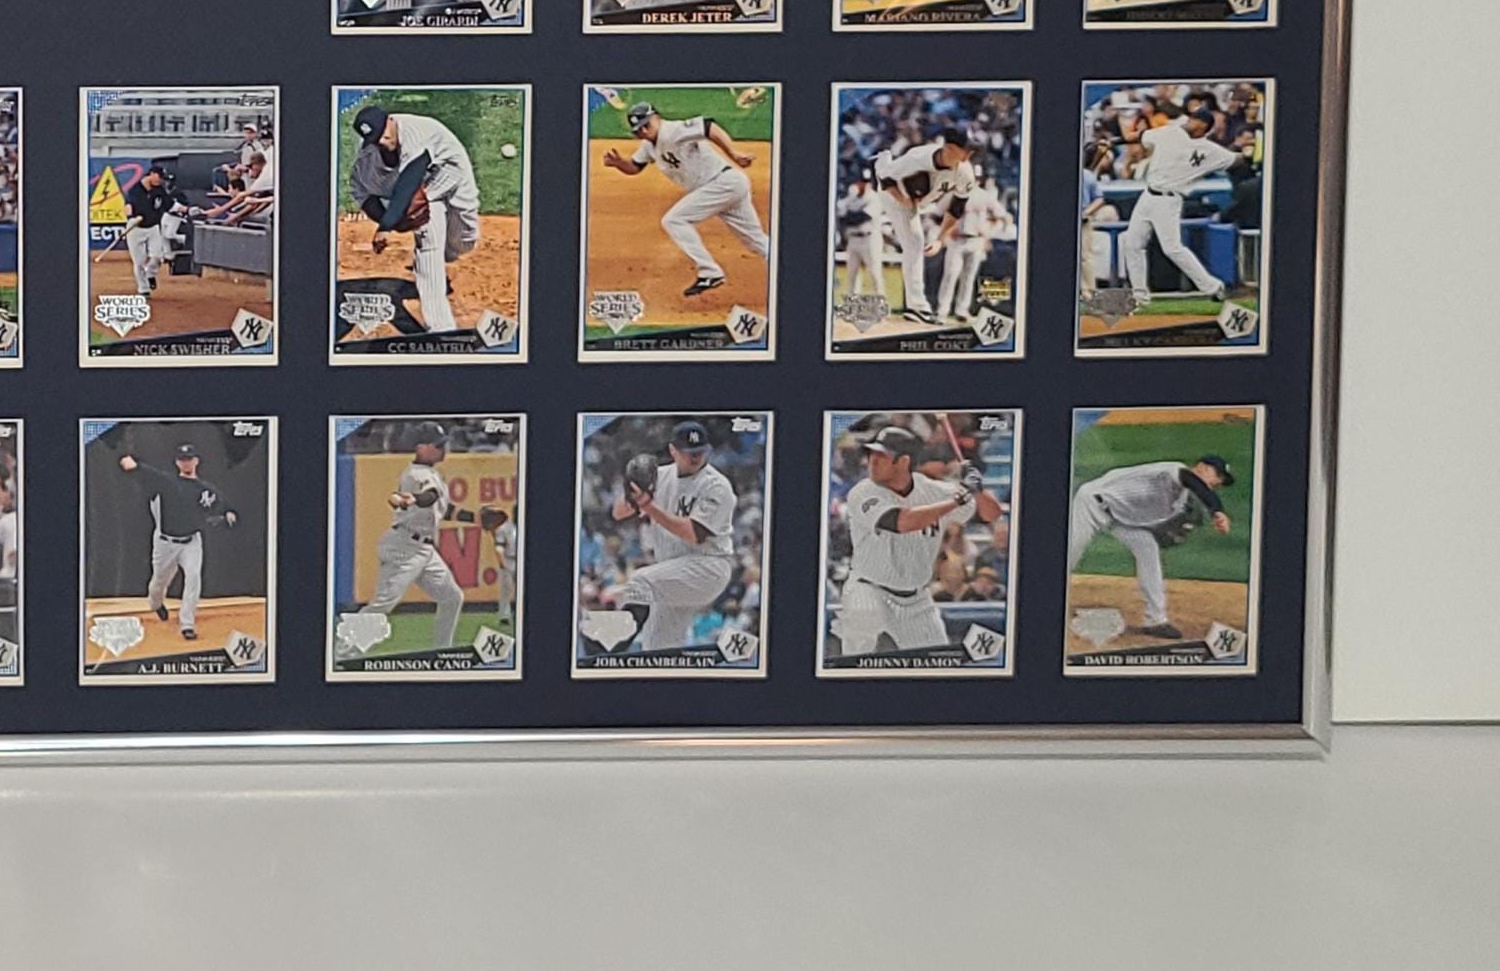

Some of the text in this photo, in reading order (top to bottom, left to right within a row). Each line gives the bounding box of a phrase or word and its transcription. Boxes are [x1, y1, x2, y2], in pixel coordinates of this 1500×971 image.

[400, 15, 479, 27] JOE GIRARDI
[642, 12, 733, 24] DEREK JETER
[930, 12, 982, 23] RIVERA
[133, 344, 230, 356] NICK SWISHER
[387, 342, 474, 353] CC SABATHIA
[614, 339, 725, 350] BRETT GARDNER
[364, 660, 472, 671] ROBINSON CANO
[594, 657, 716, 667] JOBA CHAMBERLAIN
[856, 657, 962, 668] JOHNNY DAMON
[1084, 654, 1204, 666] DAVID ROBERTSON
[162, 664, 224, 674] BURNETT
